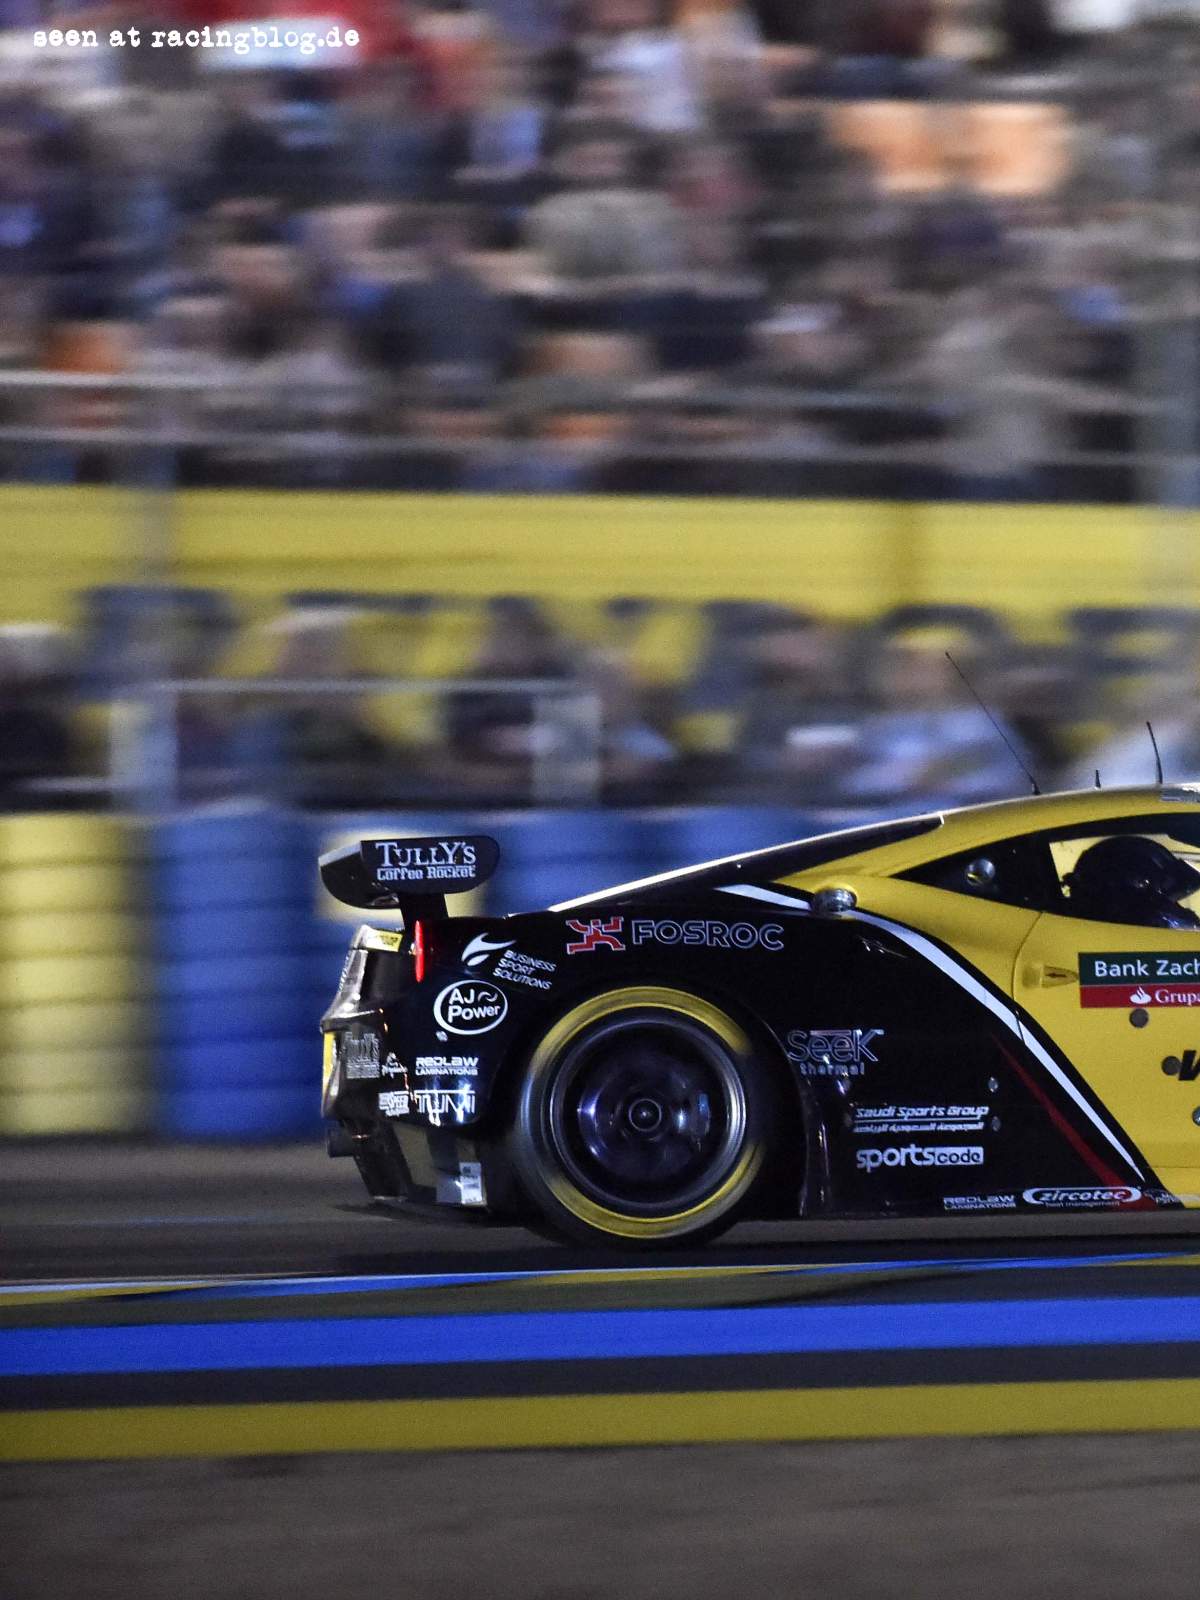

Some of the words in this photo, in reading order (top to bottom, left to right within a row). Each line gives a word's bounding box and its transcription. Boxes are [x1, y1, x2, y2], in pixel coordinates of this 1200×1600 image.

[376, 867, 423, 881] Coffee
[631, 920, 785, 950] FOSROC
[498, 958, 536, 975] SPORT
[503, 949, 557, 973] BUSINESS
[1094, 960, 1150, 977] Bank
[492, 967, 553, 990] SOLUTIONS
[449, 988, 475, 1005] AJ
[448, 1005, 501, 1023] Power
[415, 1067, 478, 1076] LAMINATIONS
[946, 1105, 989, 1120] Group
[1039, 1188, 1126, 1201] zircotec
